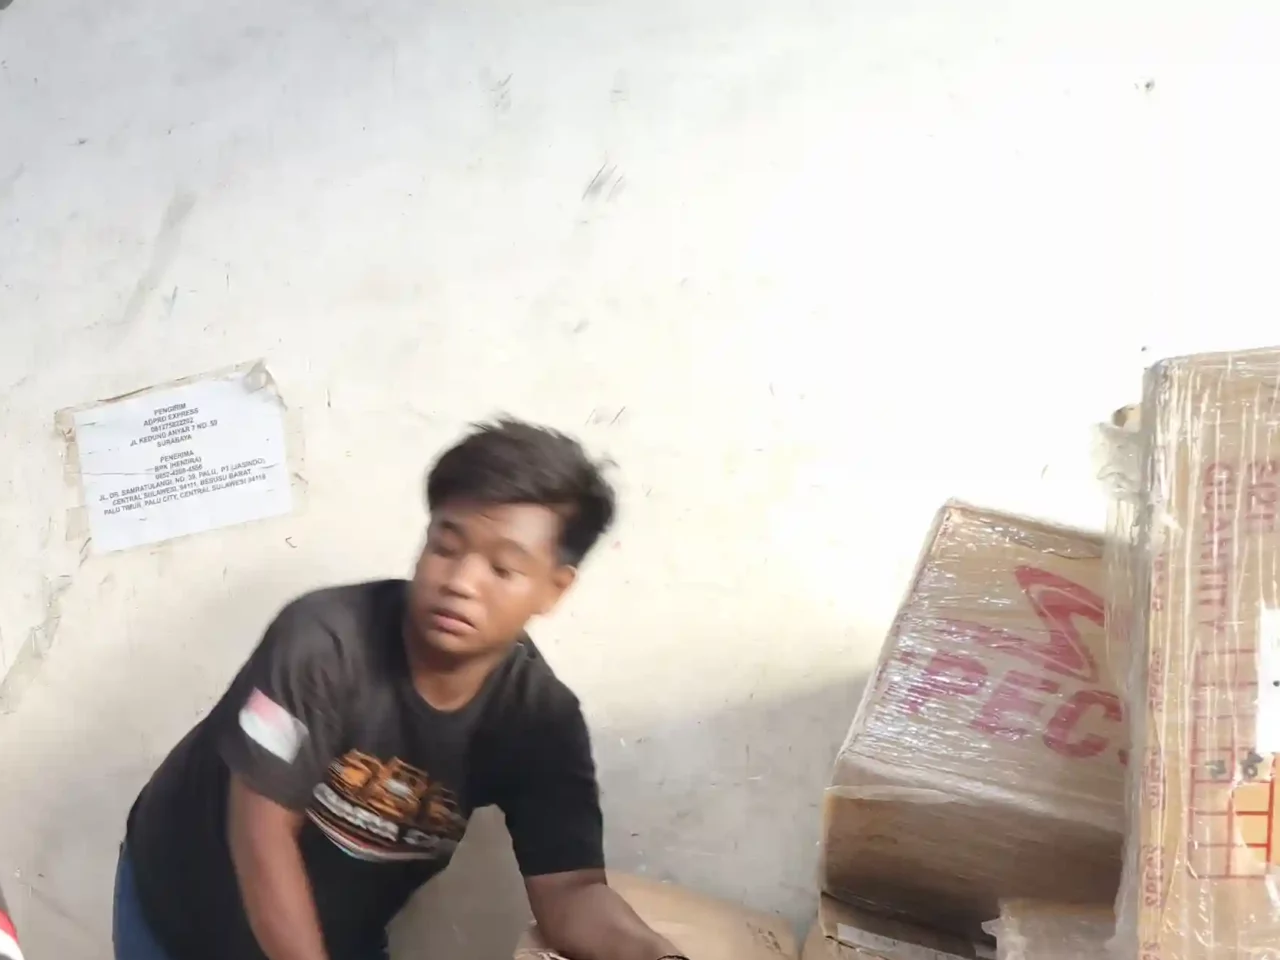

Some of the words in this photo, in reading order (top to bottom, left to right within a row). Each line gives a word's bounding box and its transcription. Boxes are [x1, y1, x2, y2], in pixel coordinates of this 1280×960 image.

[152, 402, 187, 416] PENGIRIM
[167, 407, 199, 420] EXPRESS
[168, 426, 191, 437] ANYAR
[157, 433, 193, 447] SURABAYA
[160, 449, 195, 463] PENERIMA
[104, 506, 121, 516] PALU
[144, 498, 161, 507] PALU
[179, 487, 210, 499] CENTRAL
[211, 478, 247, 491] SULAWESI
[112, 494, 142, 507] CENTRAL
